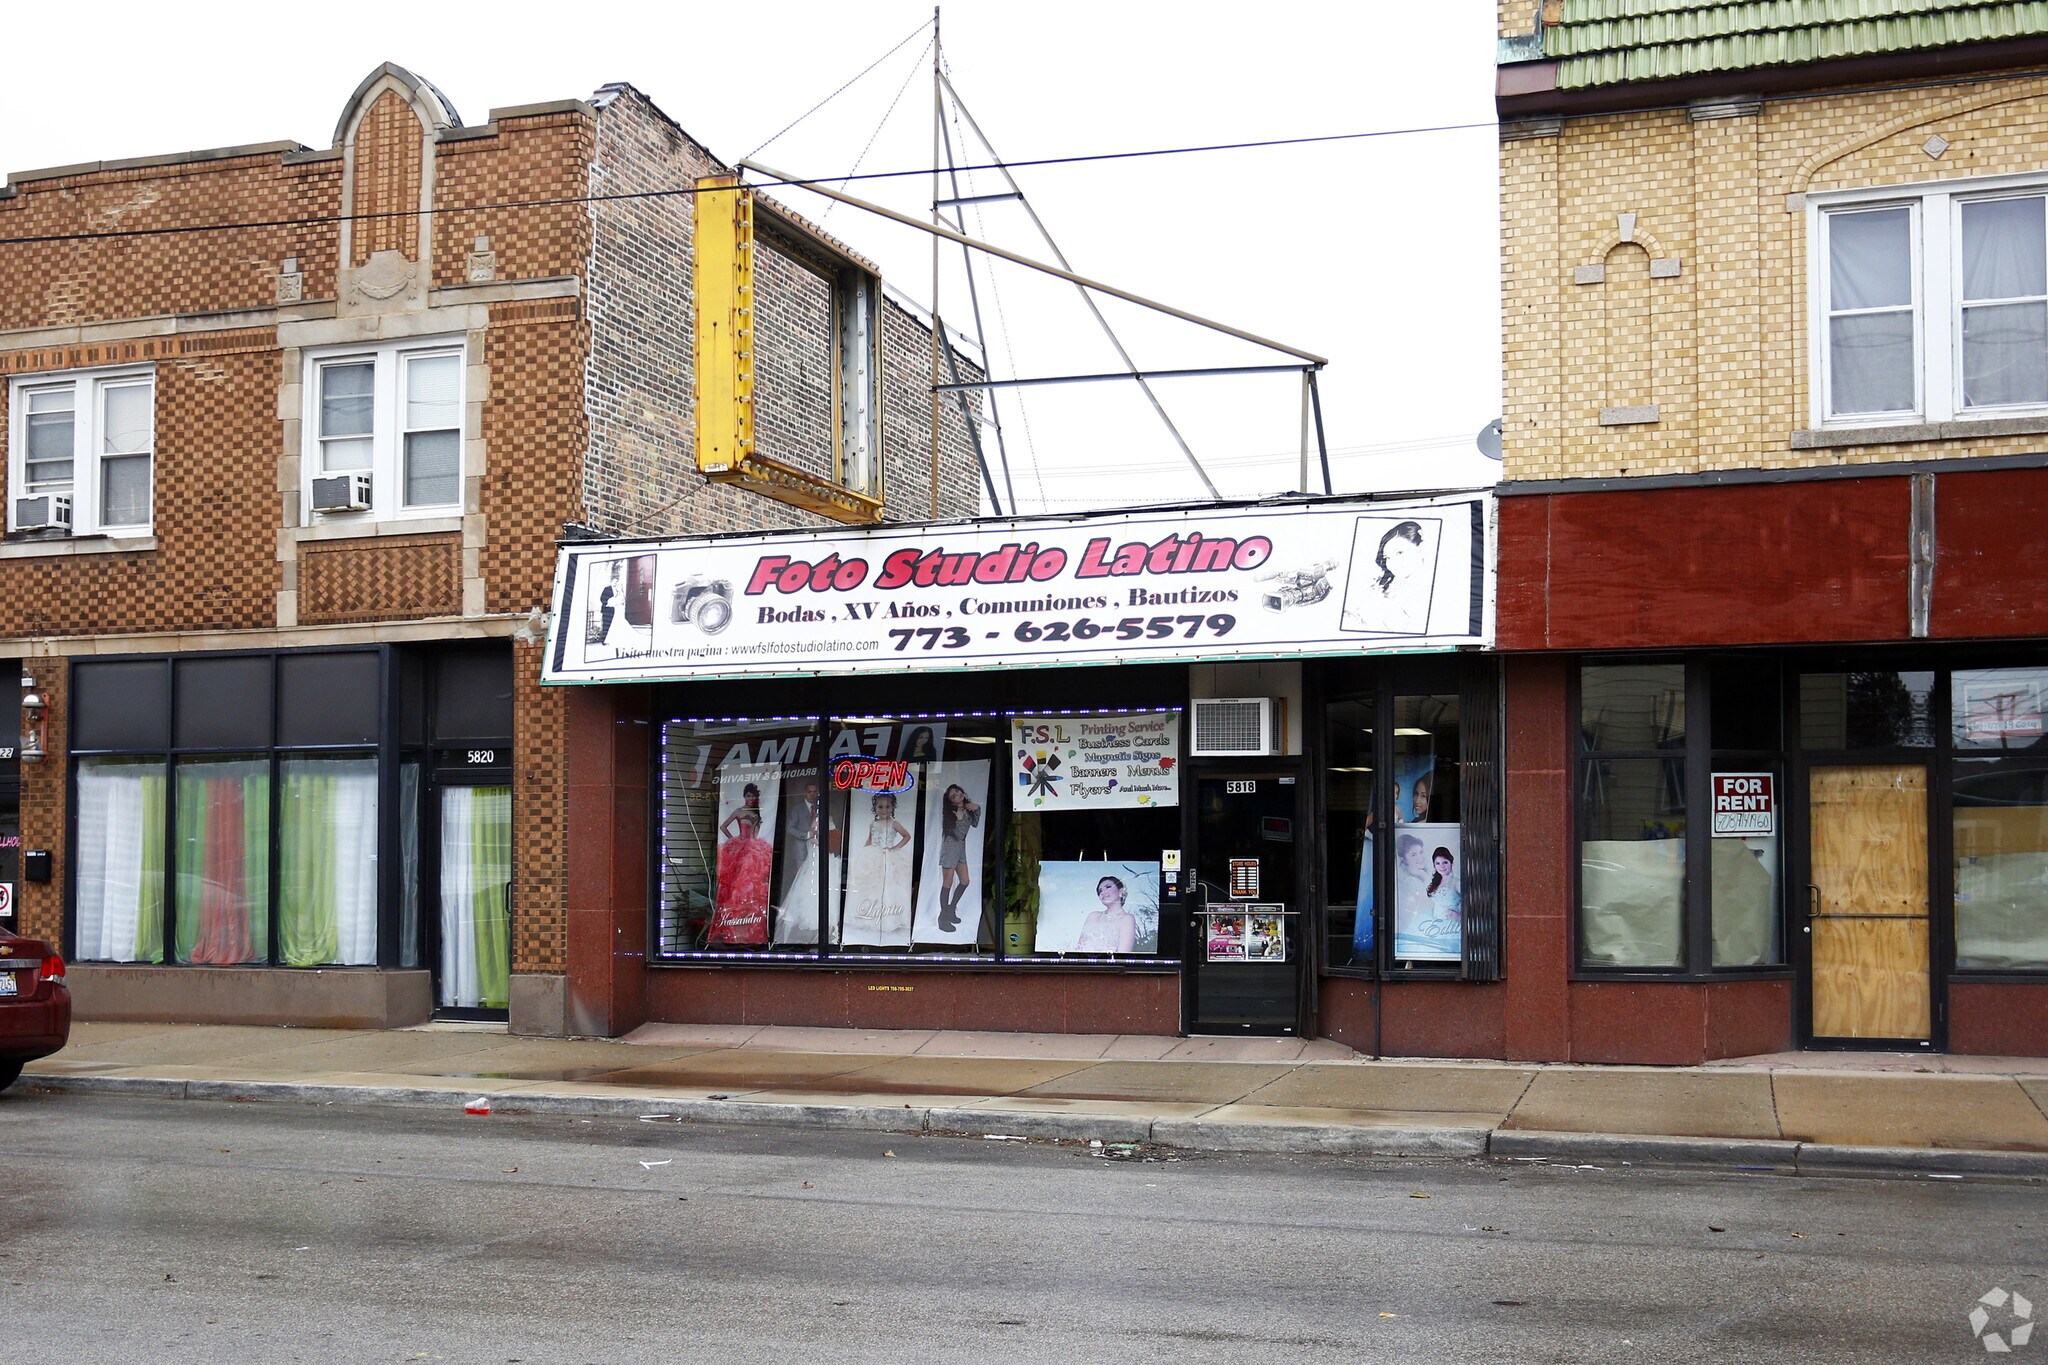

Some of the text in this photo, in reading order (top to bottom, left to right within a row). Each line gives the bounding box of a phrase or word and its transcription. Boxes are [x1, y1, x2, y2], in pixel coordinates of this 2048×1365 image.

[744, 531, 1273, 596] Foto Studio Latino
[842, 601, 880, 620] XV
[1128, 586, 1239, 607] Bautizos
[888, 627, 971, 651] 773
[1014, 614, 1236, 643] 626-5579
[648, 645, 685, 659] nuestra
[686, 643, 722, 660] pagina
[1080, 721, 1165, 736] Printing Service
[1078, 733, 1170, 749] Business Cards
[467, 750, 494, 763] 5820
[1084, 750, 1161, 765] Magnetic Signs
[834, 760, 908, 790] OPEN
[1070, 765, 1170, 778] Banners Menus
[1070, 783, 1112, 799] Flyers
[1227, 781, 1255, 792] 5818
[1723, 779, 1762, 794] FOR
[1717, 795, 1769, 811] RENT
[715, 913, 762, 928] Kassandra
